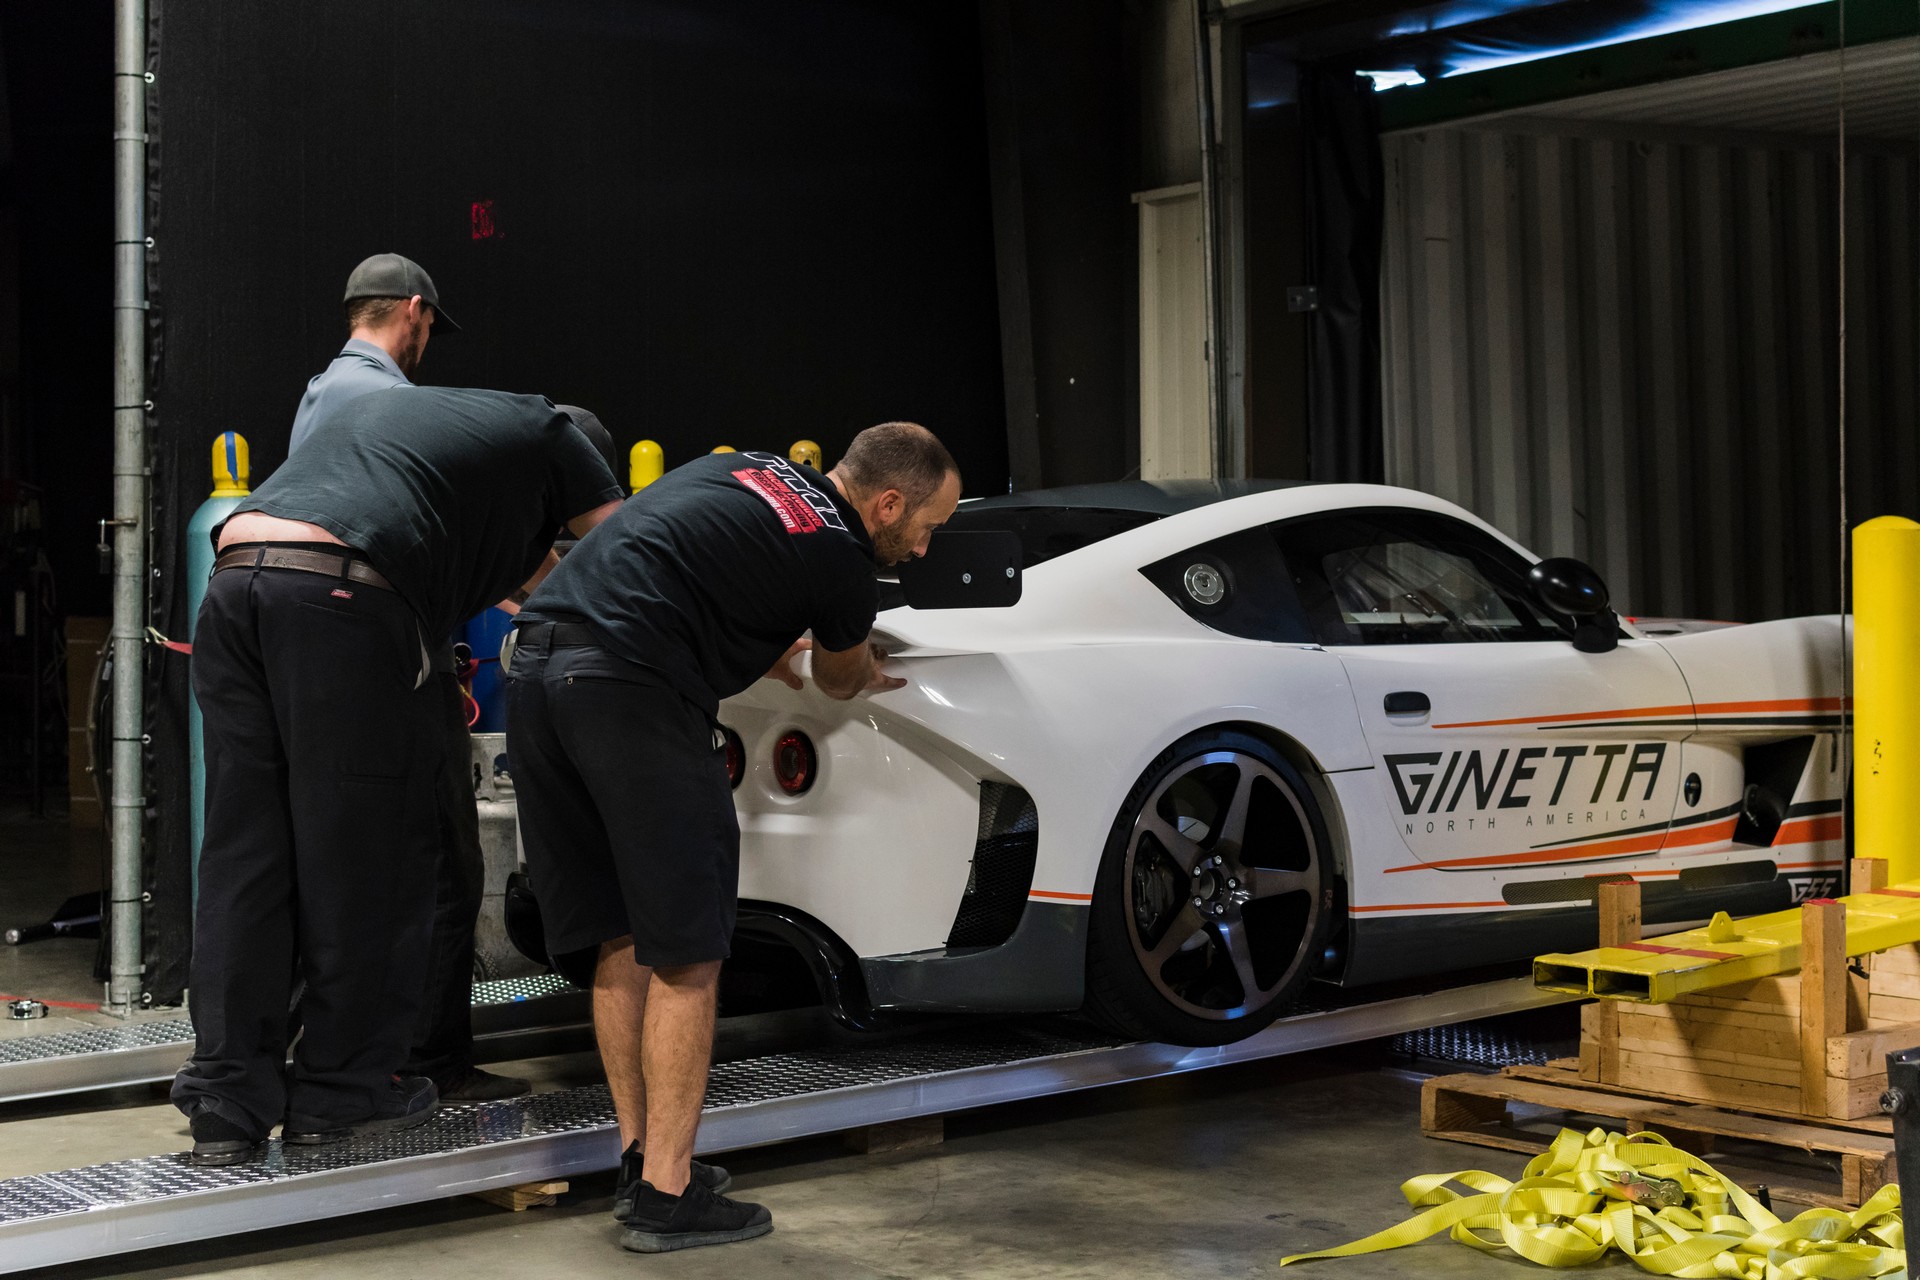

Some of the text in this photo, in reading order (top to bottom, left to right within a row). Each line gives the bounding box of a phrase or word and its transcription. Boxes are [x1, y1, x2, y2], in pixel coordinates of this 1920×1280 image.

[788, 491, 825, 528] Products
[1382, 742, 1668, 815] GINETTA
[1405, 808, 1647, 835] NORTH AMERICA
